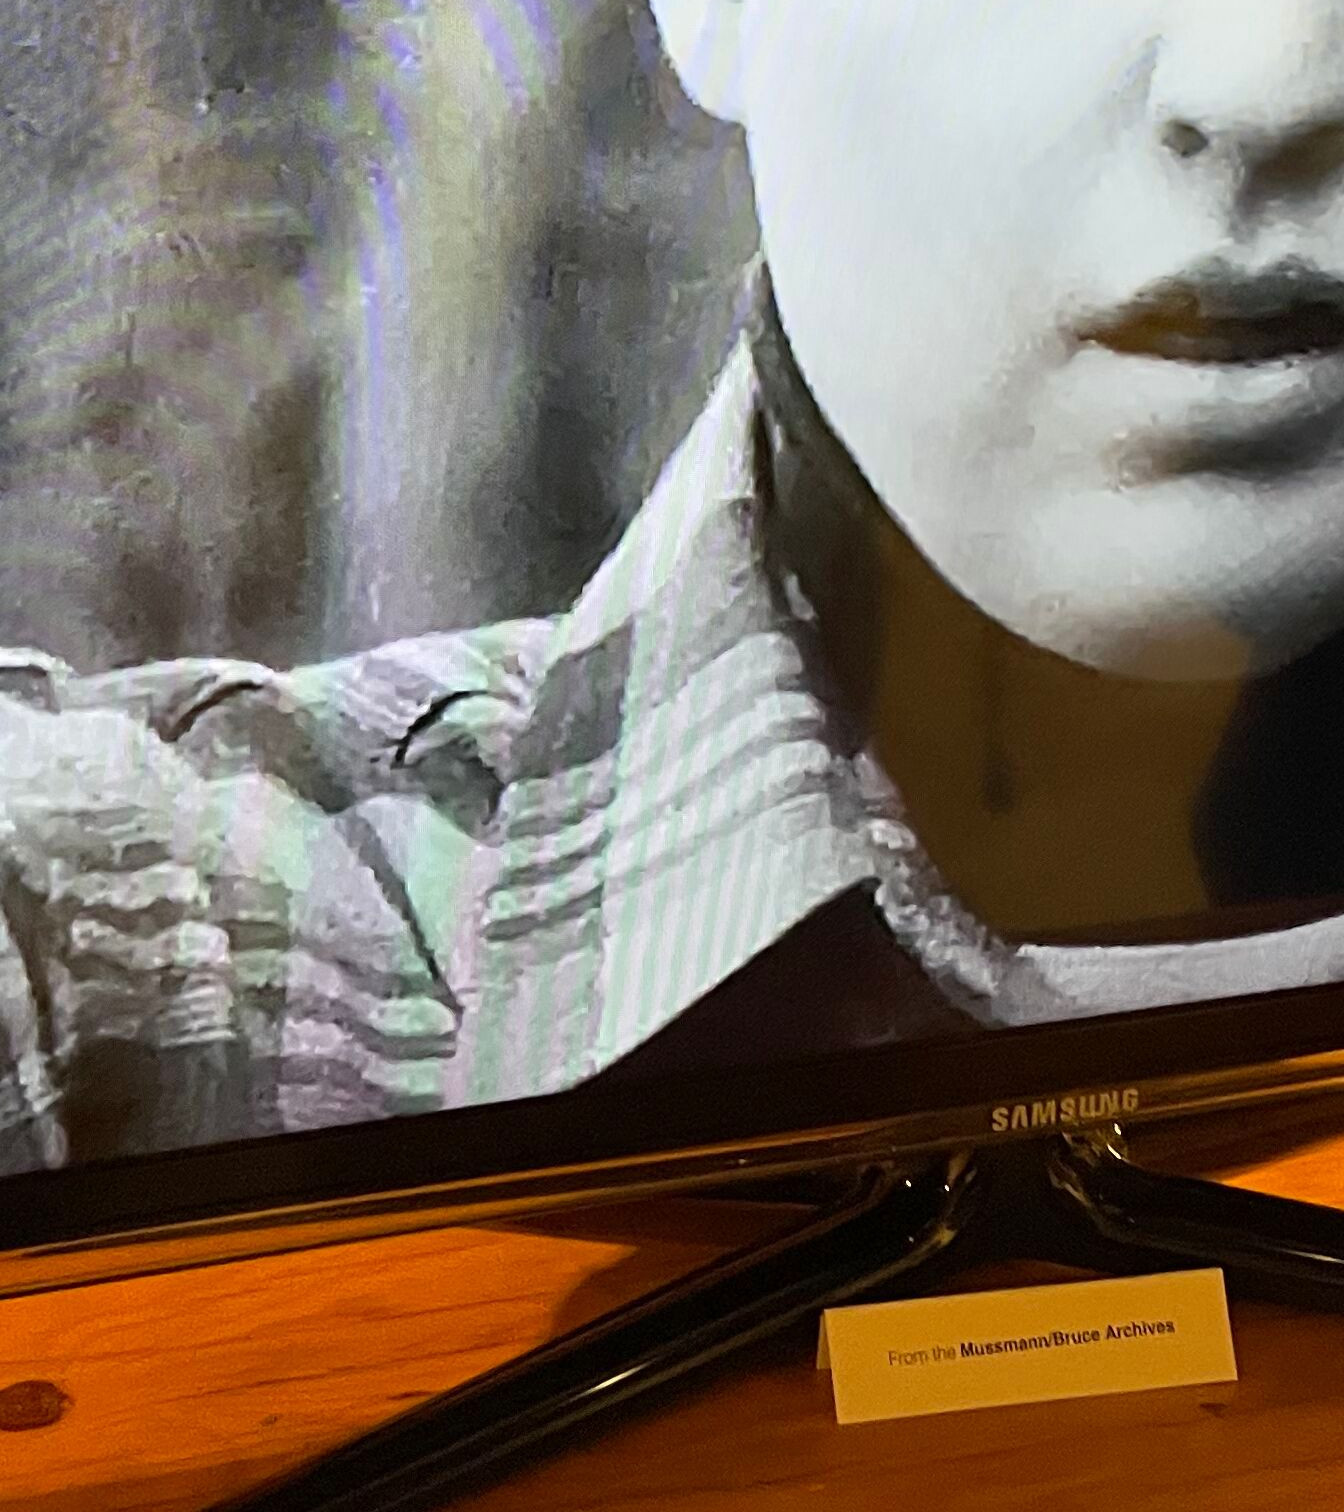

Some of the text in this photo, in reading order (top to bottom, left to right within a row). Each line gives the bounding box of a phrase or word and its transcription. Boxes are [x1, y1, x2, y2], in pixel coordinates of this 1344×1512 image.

[991, 1088, 1139, 1132] SAMSUNG
[887, 1319, 1176, 1367] From the Mussmann/Bruce Archives
